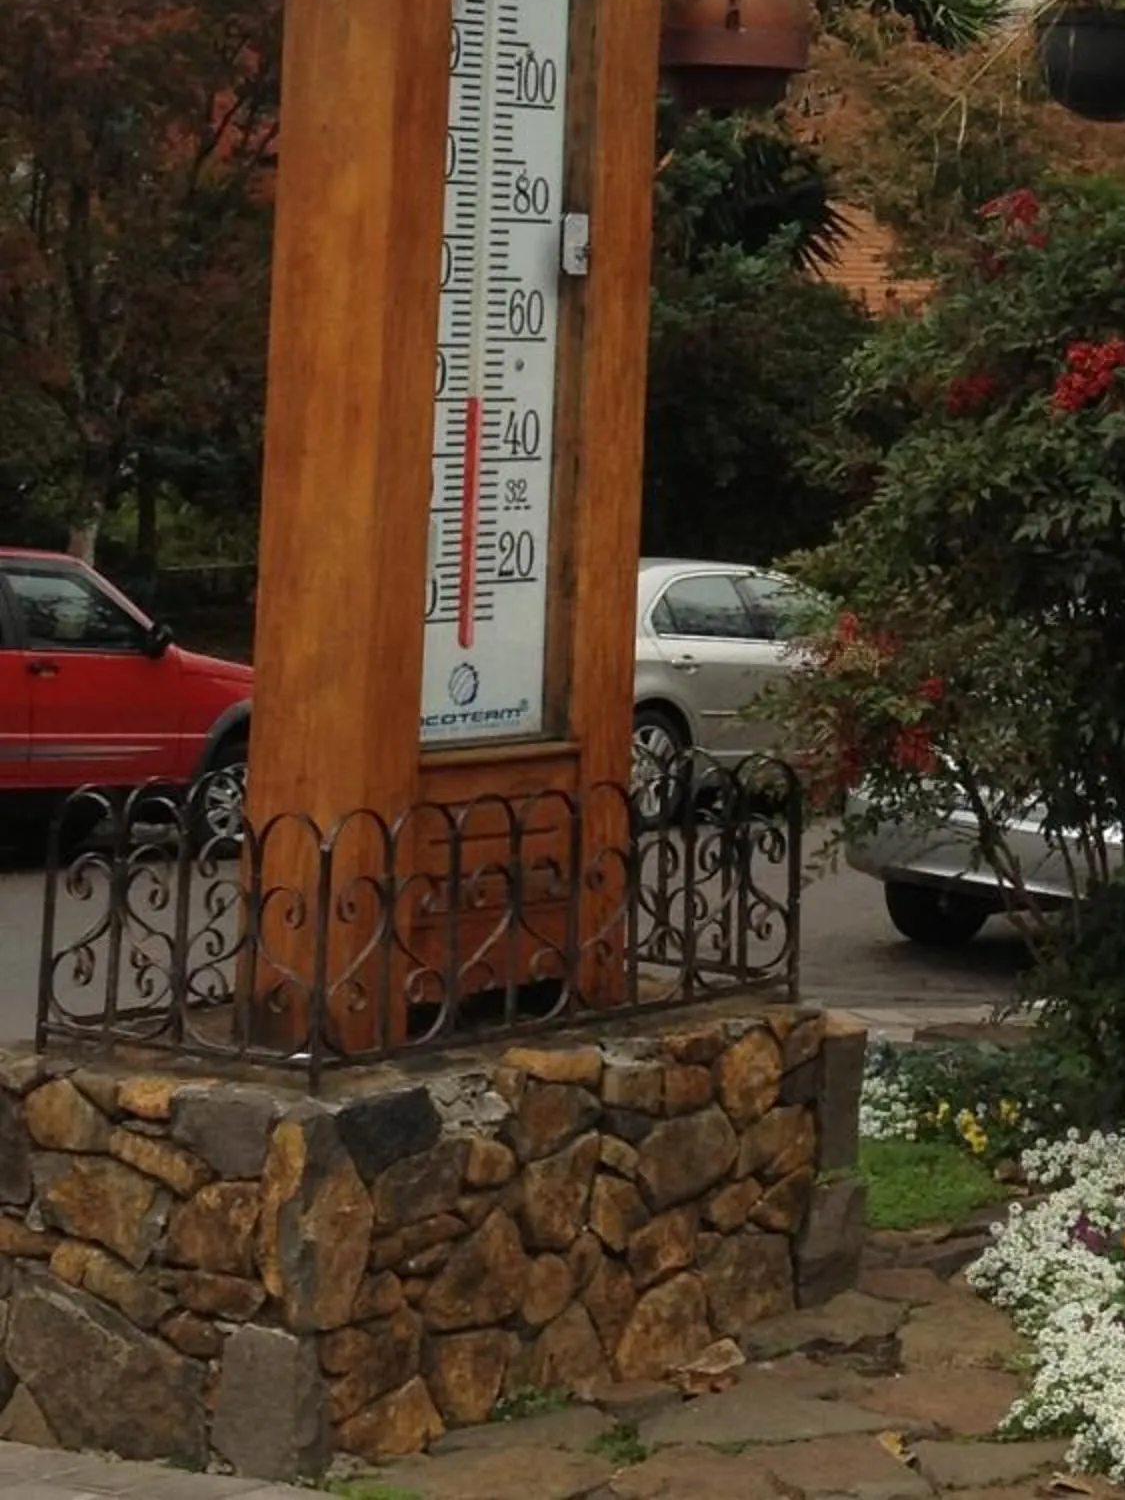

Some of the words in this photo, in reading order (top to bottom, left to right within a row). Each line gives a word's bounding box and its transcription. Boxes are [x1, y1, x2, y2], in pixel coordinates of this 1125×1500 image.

[515, 58, 557, 103] 100
[513, 174, 549, 215] 80
[509, 289, 544, 335] 60
[503, 409, 541, 455] 40
[504, 478, 528, 504] 32
[497, 530, 535, 577] 20
